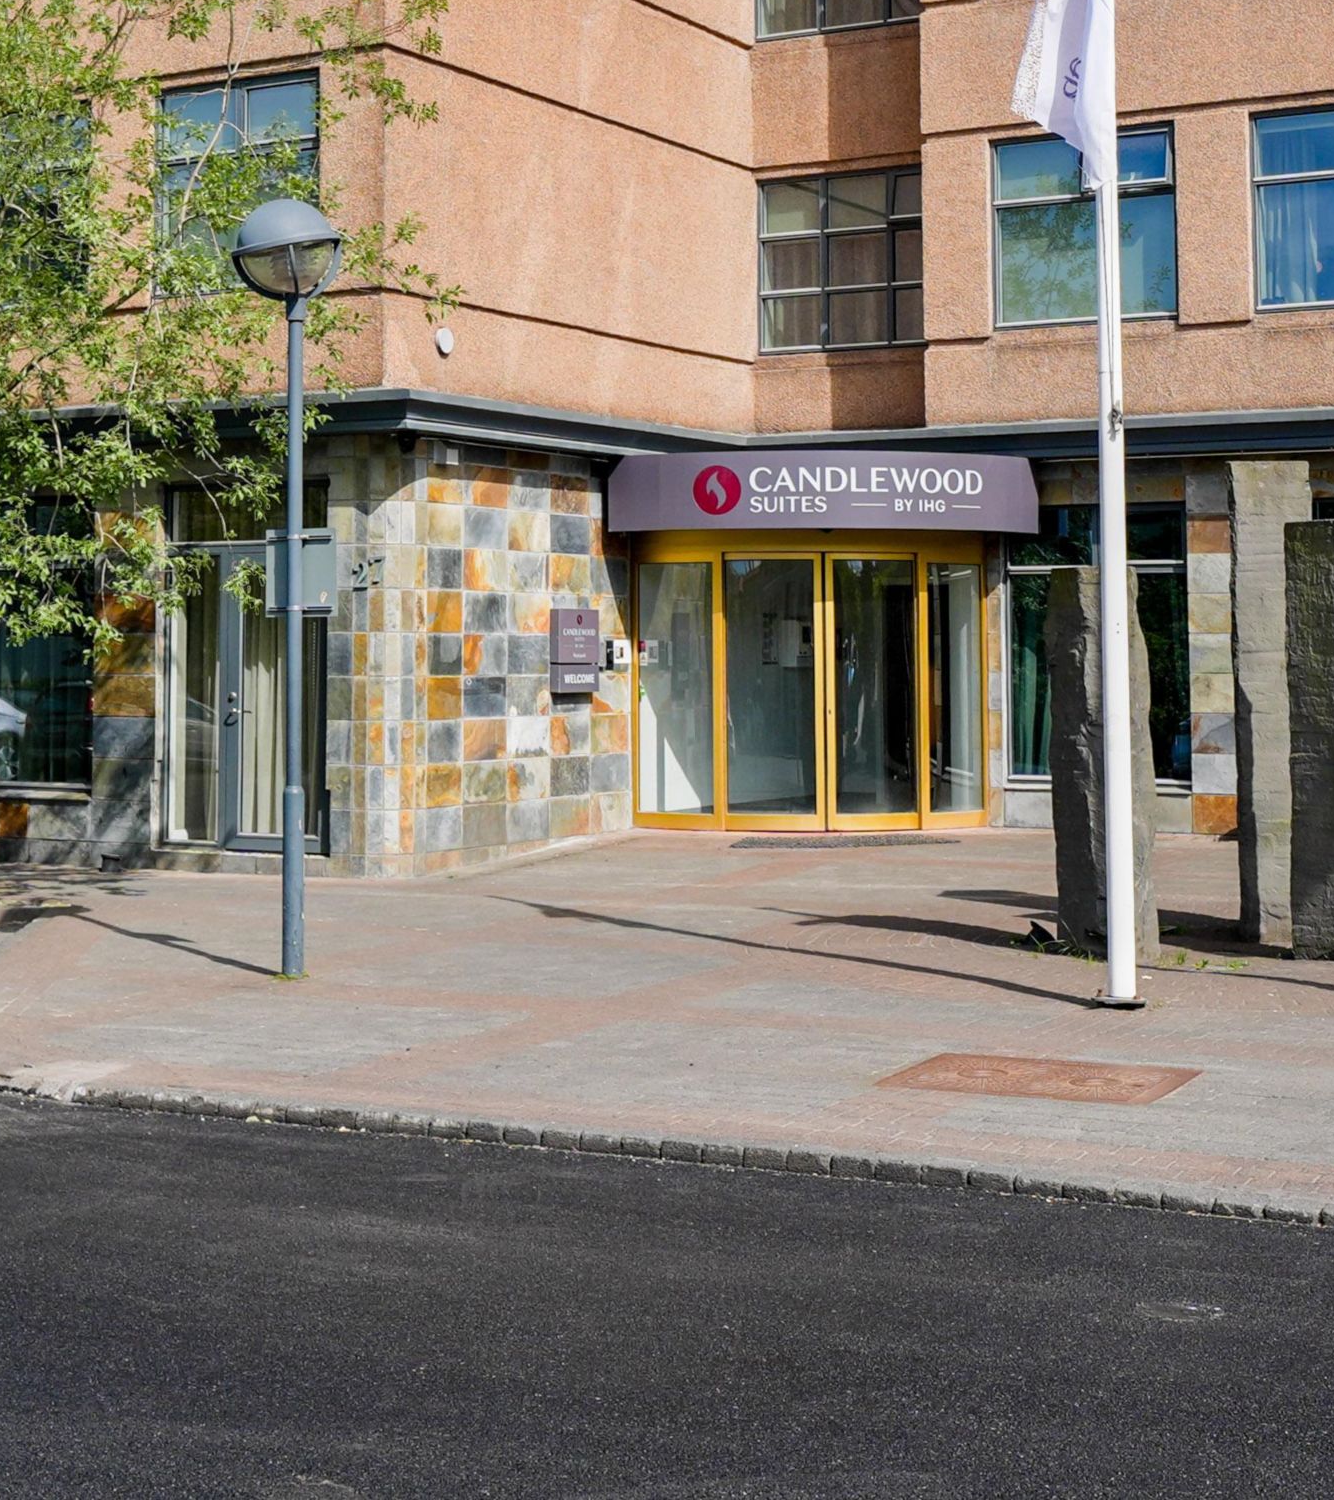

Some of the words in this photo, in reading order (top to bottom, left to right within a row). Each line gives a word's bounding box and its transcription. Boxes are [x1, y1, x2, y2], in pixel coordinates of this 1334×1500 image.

[749, 466, 983, 495] CANDLEWOOD
[749, 496, 827, 514] SUITES
[894, 499, 915, 513] BY
[919, 499, 946, 513] IHG
[352, 556, 386, 592] 27
[563, 673, 596, 685] WELCOME
